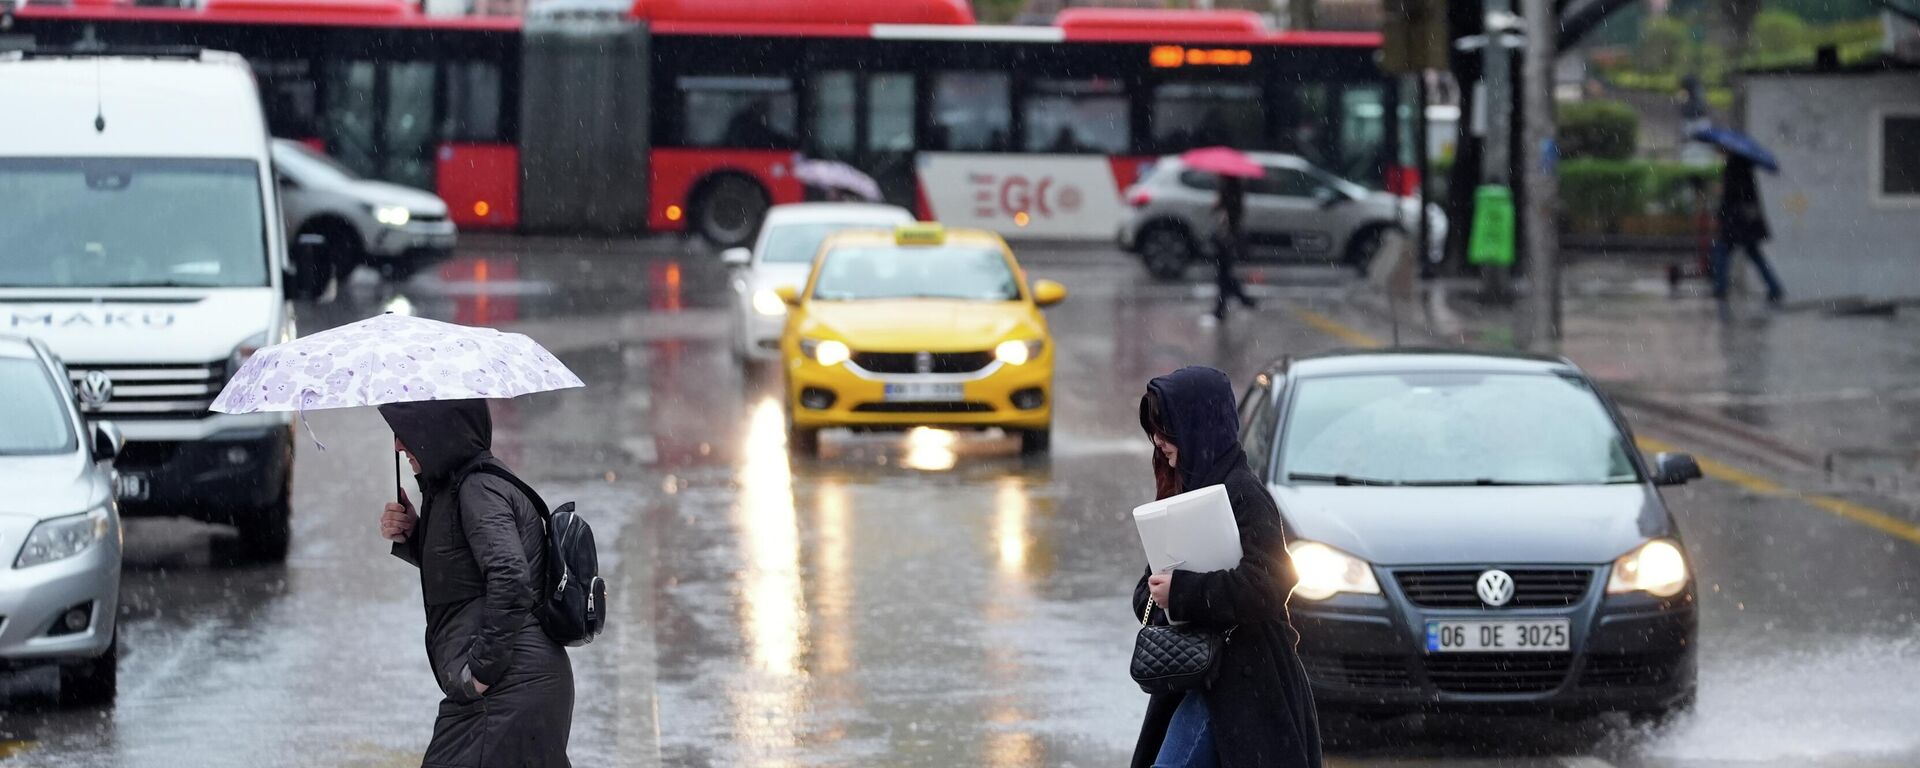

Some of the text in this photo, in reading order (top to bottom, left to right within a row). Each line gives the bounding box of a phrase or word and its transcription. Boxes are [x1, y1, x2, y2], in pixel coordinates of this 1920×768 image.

[1441, 626, 1464, 646] 06
[1480, 626, 1503, 646] DE
[1517, 625, 1565, 646] 3025
